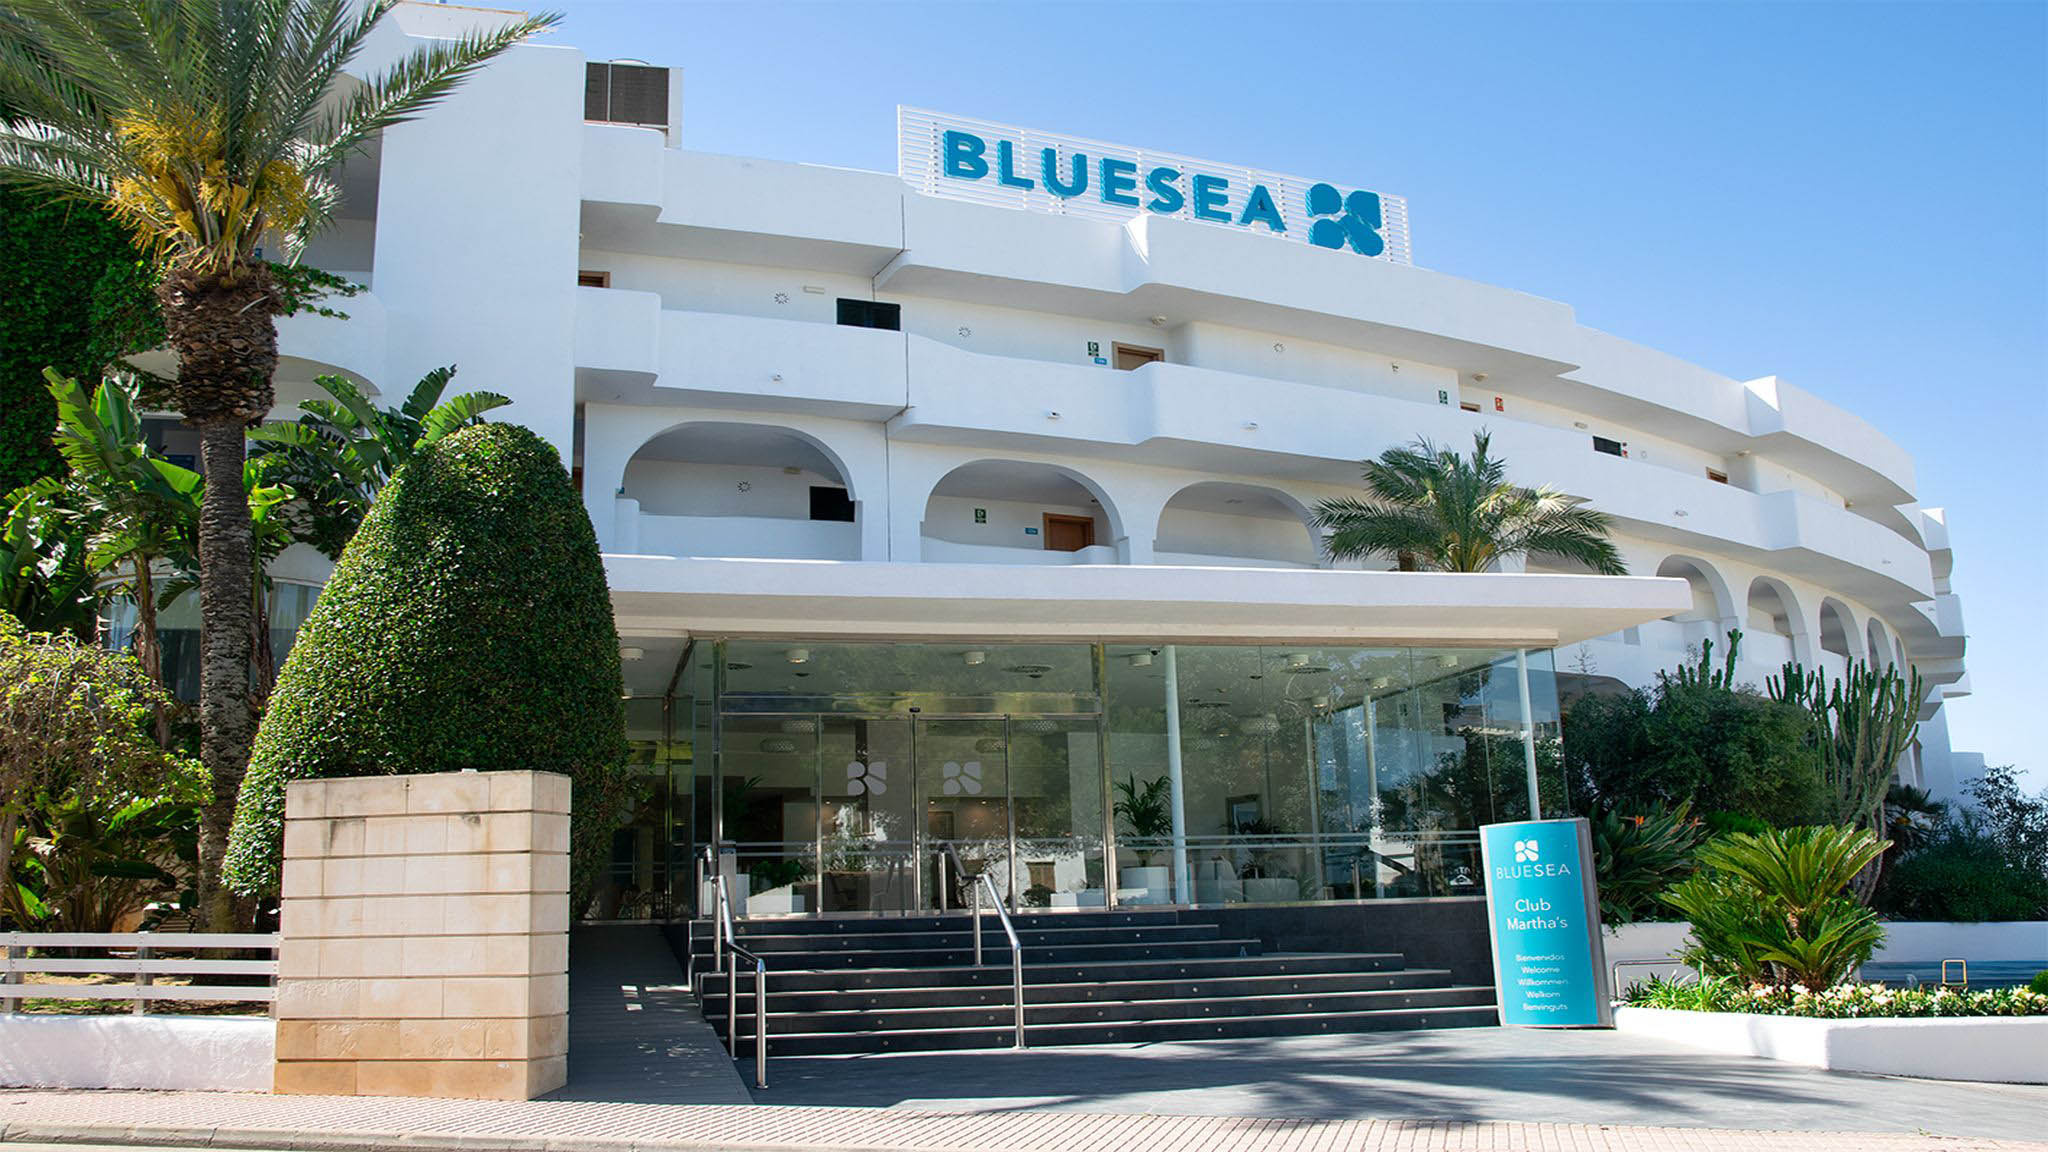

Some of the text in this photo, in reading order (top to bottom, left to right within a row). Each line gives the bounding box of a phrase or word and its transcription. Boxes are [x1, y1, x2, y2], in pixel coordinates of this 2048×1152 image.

[942, 129, 1288, 233] BLUESEA
[1496, 863, 1571, 880] BLUESEA
[1515, 898, 1551, 913] Club
[1506, 916, 1569, 931] Martha's
[1521, 966, 1561, 975] Welcome
